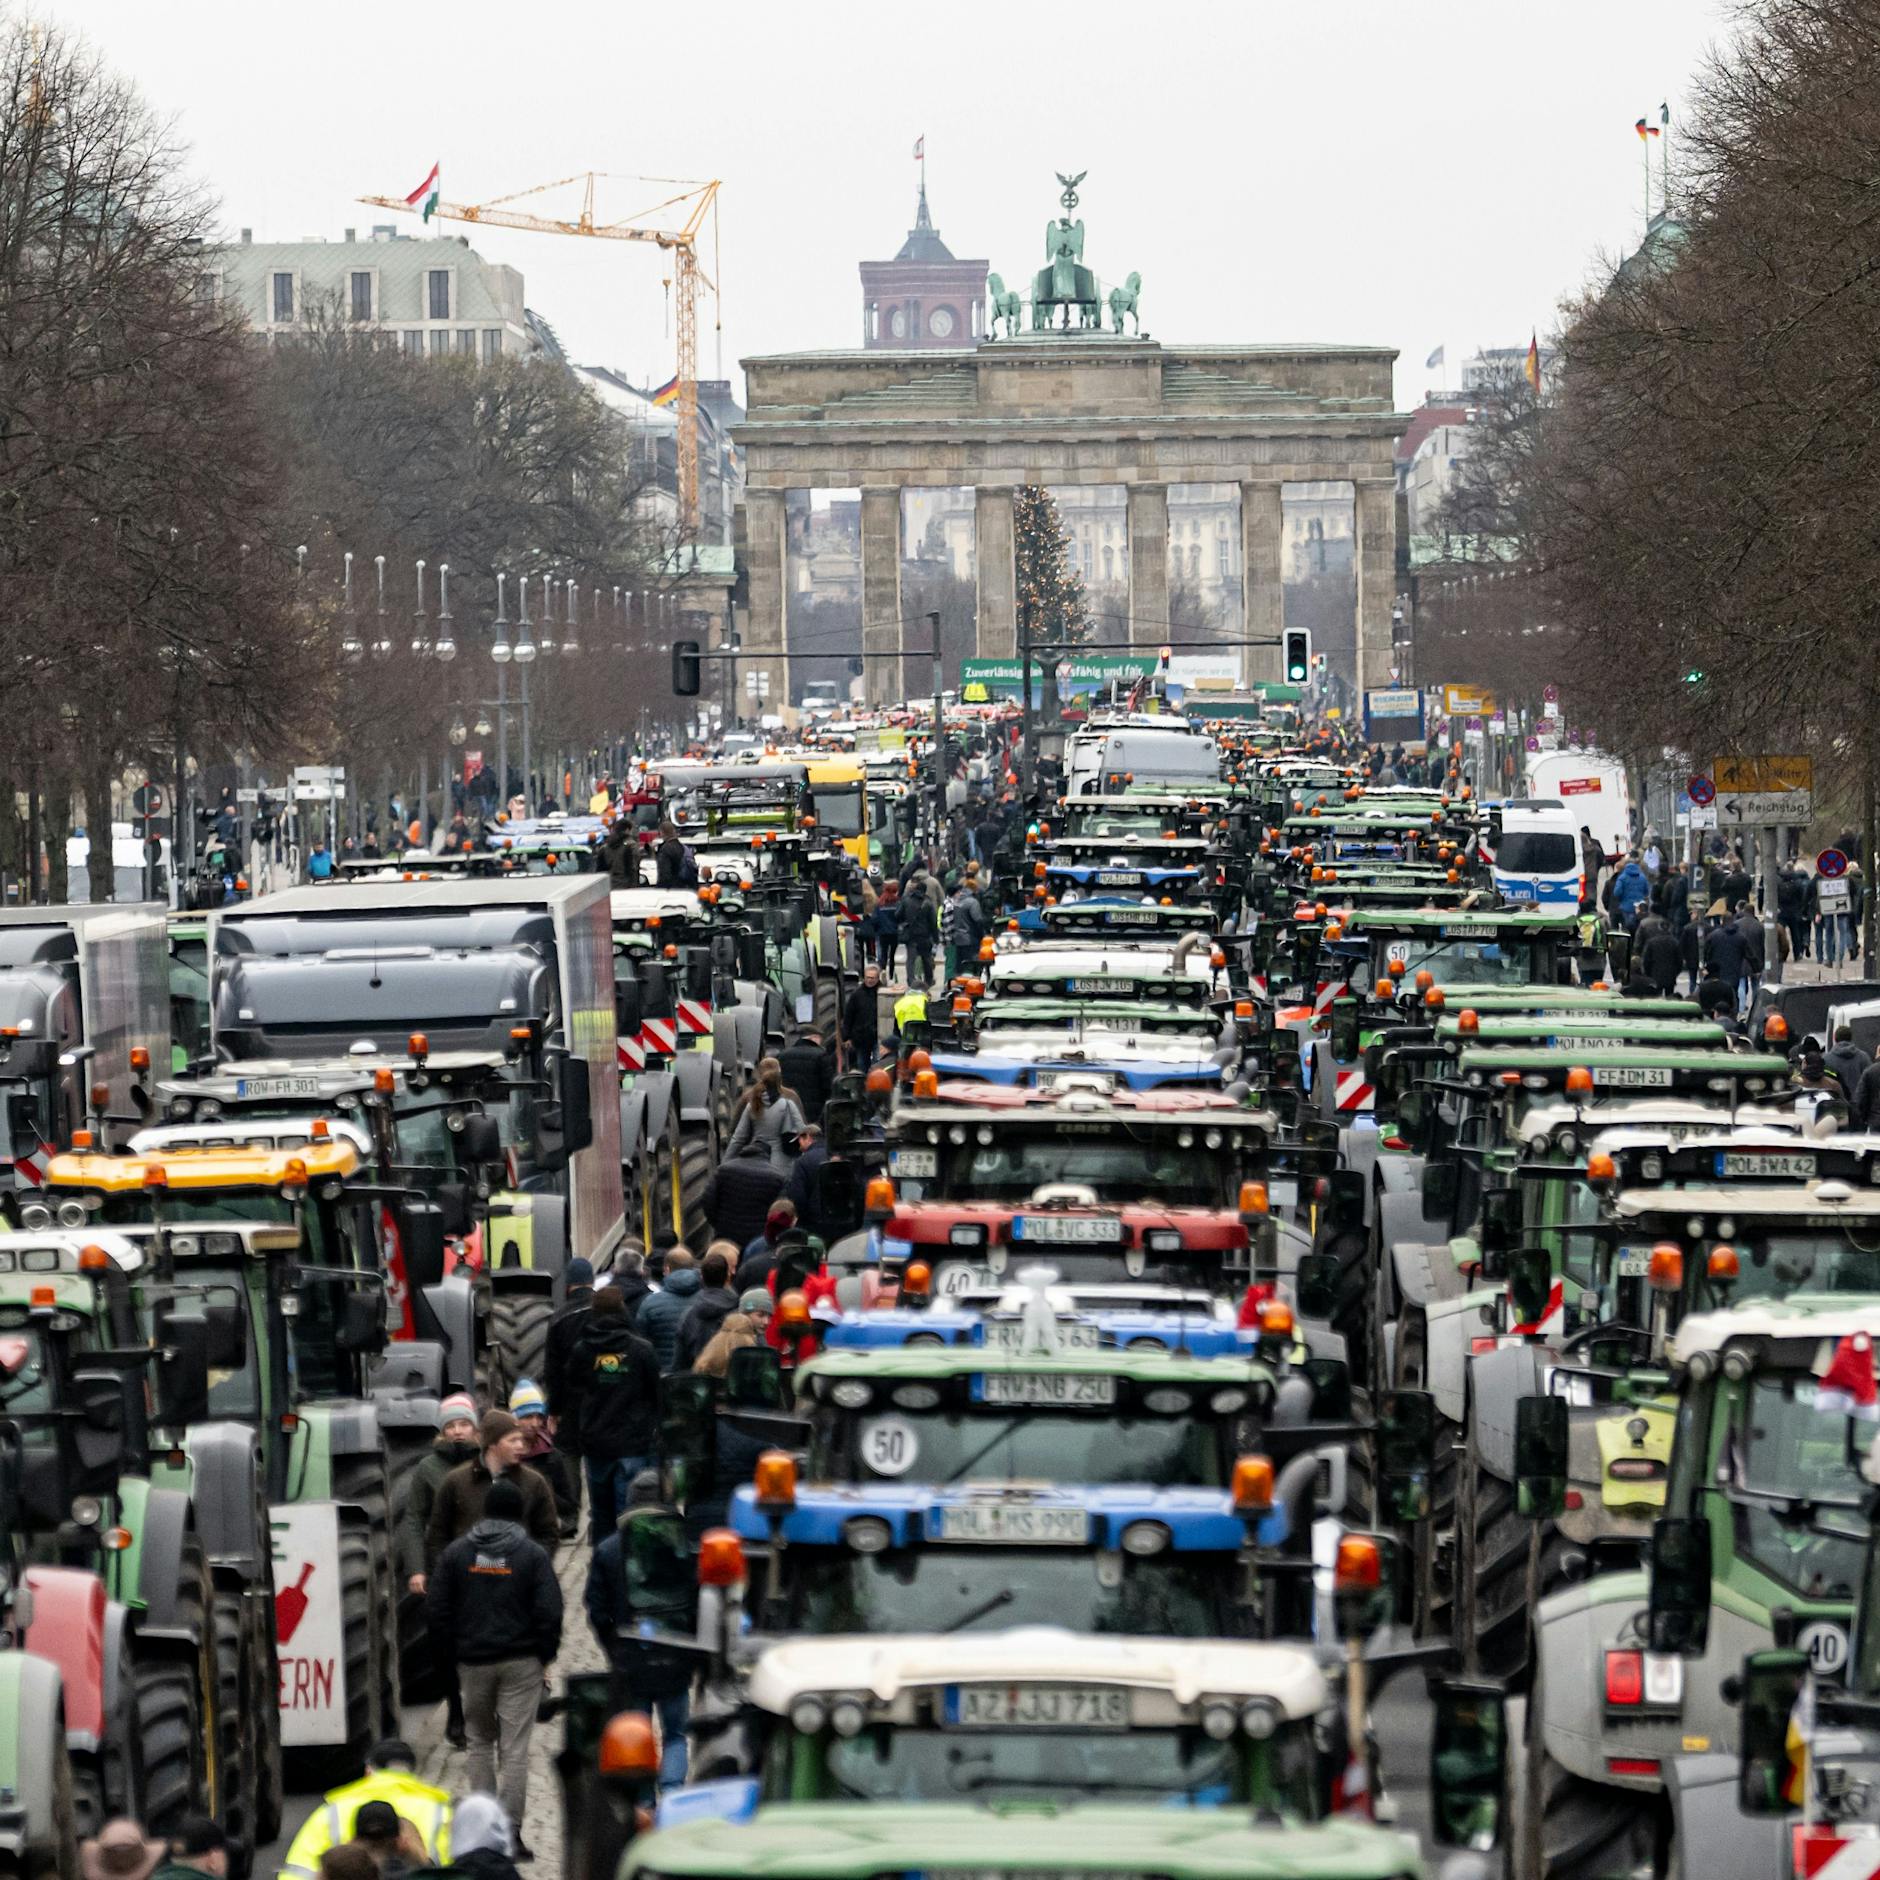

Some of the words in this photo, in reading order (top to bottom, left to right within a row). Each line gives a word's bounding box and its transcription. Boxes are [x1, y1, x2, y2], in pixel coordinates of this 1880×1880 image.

[1748, 801, 1804, 816] Reichstag
[1391, 946, 1406, 960] 50
[1598, 1070, 1617, 1084] FF
[1627, 1070, 1646, 1084] DM
[1648, 1070, 1666, 1084] 31
[246, 1082, 269, 1095] ROW
[275, 1081, 291, 1093] FH
[293, 1079, 315, 1092] 301
[1727, 1157, 1757, 1174] MOL
[1766, 1157, 1788, 1174] WA
[1794, 1158, 1815, 1174] 42
[1089, 1221, 1117, 1239] 333
[875, 1431, 904, 1464] 50
[1809, 1634, 1837, 1664] 40
